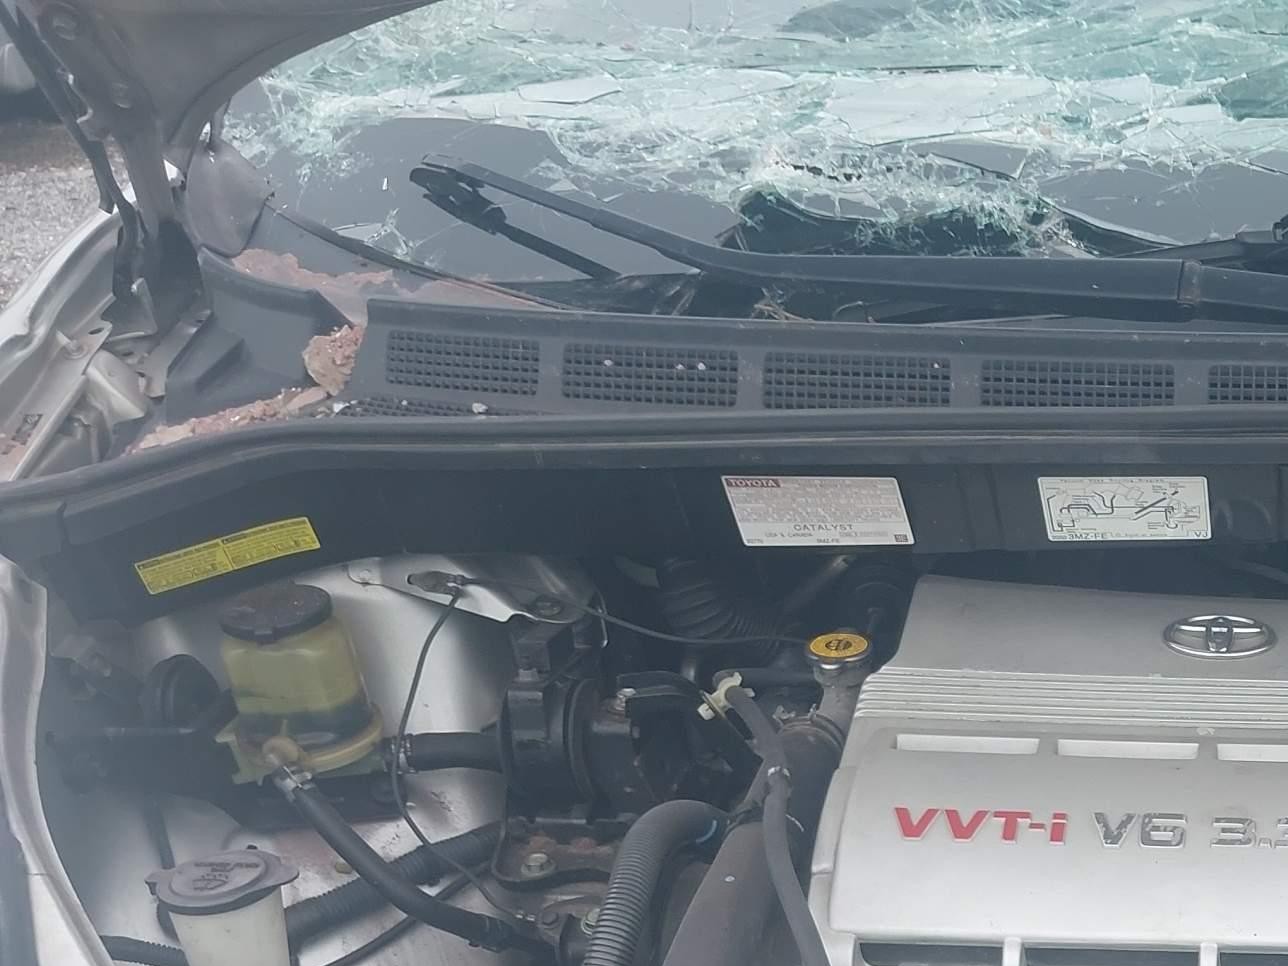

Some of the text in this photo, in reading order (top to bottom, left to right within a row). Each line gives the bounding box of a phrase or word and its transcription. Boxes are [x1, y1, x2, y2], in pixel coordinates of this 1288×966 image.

[728, 479, 778, 488] TOYOTA
[793, 523, 854, 532] CATALYST
[893, 806, 1070, 845] VVT-i
[1092, 811, 1188, 849] V6
